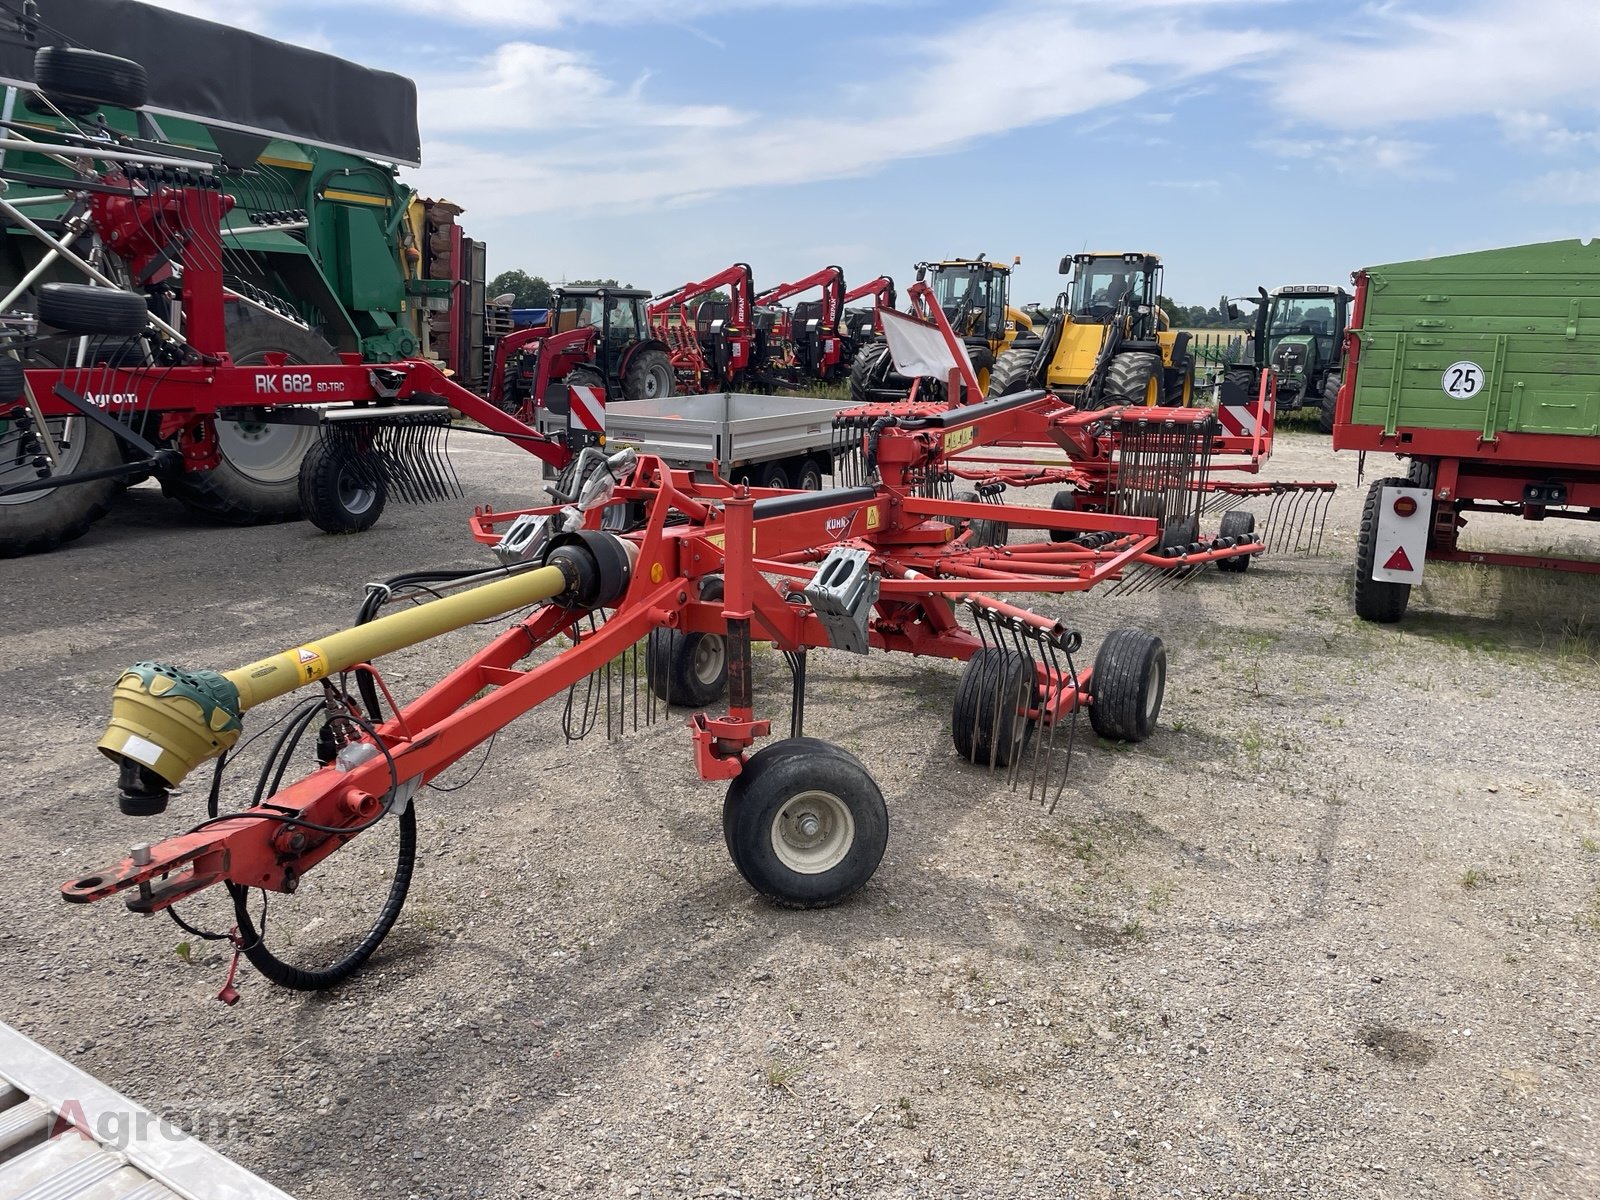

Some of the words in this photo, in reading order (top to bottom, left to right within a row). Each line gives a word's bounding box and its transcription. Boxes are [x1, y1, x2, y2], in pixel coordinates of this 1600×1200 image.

[255, 374, 279, 394] RK
[282, 374, 312, 393] 662
[316, 382, 345, 392] SD-TRC
[1449, 368, 1476, 393] 25
[85, 391, 139, 408] Agrom
[826, 518, 845, 529] KUHN
